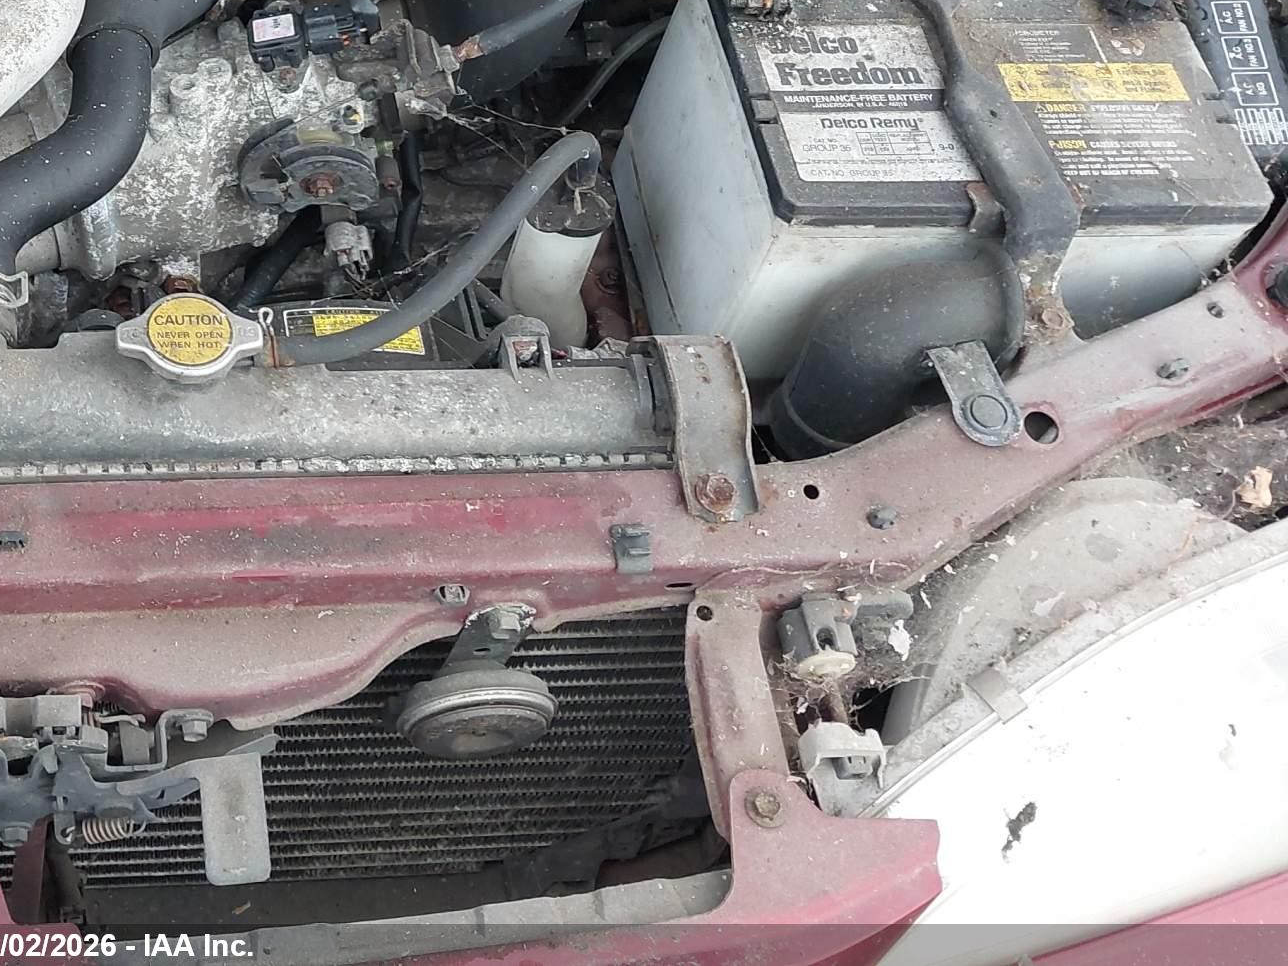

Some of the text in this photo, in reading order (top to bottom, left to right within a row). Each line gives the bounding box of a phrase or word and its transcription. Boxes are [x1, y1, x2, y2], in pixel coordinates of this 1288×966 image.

[774, 62, 924, 86] Freedom
[783, 93, 934, 104] MAINTENANCE-FREE BATTERY
[820, 117, 920, 131] Delco Remy
[802, 144, 838, 152] GROUP
[153, 314, 223, 326] CAUTION
[156, 331, 224, 340] NEVER OPEN
[158, 340, 192, 349] WHEN
